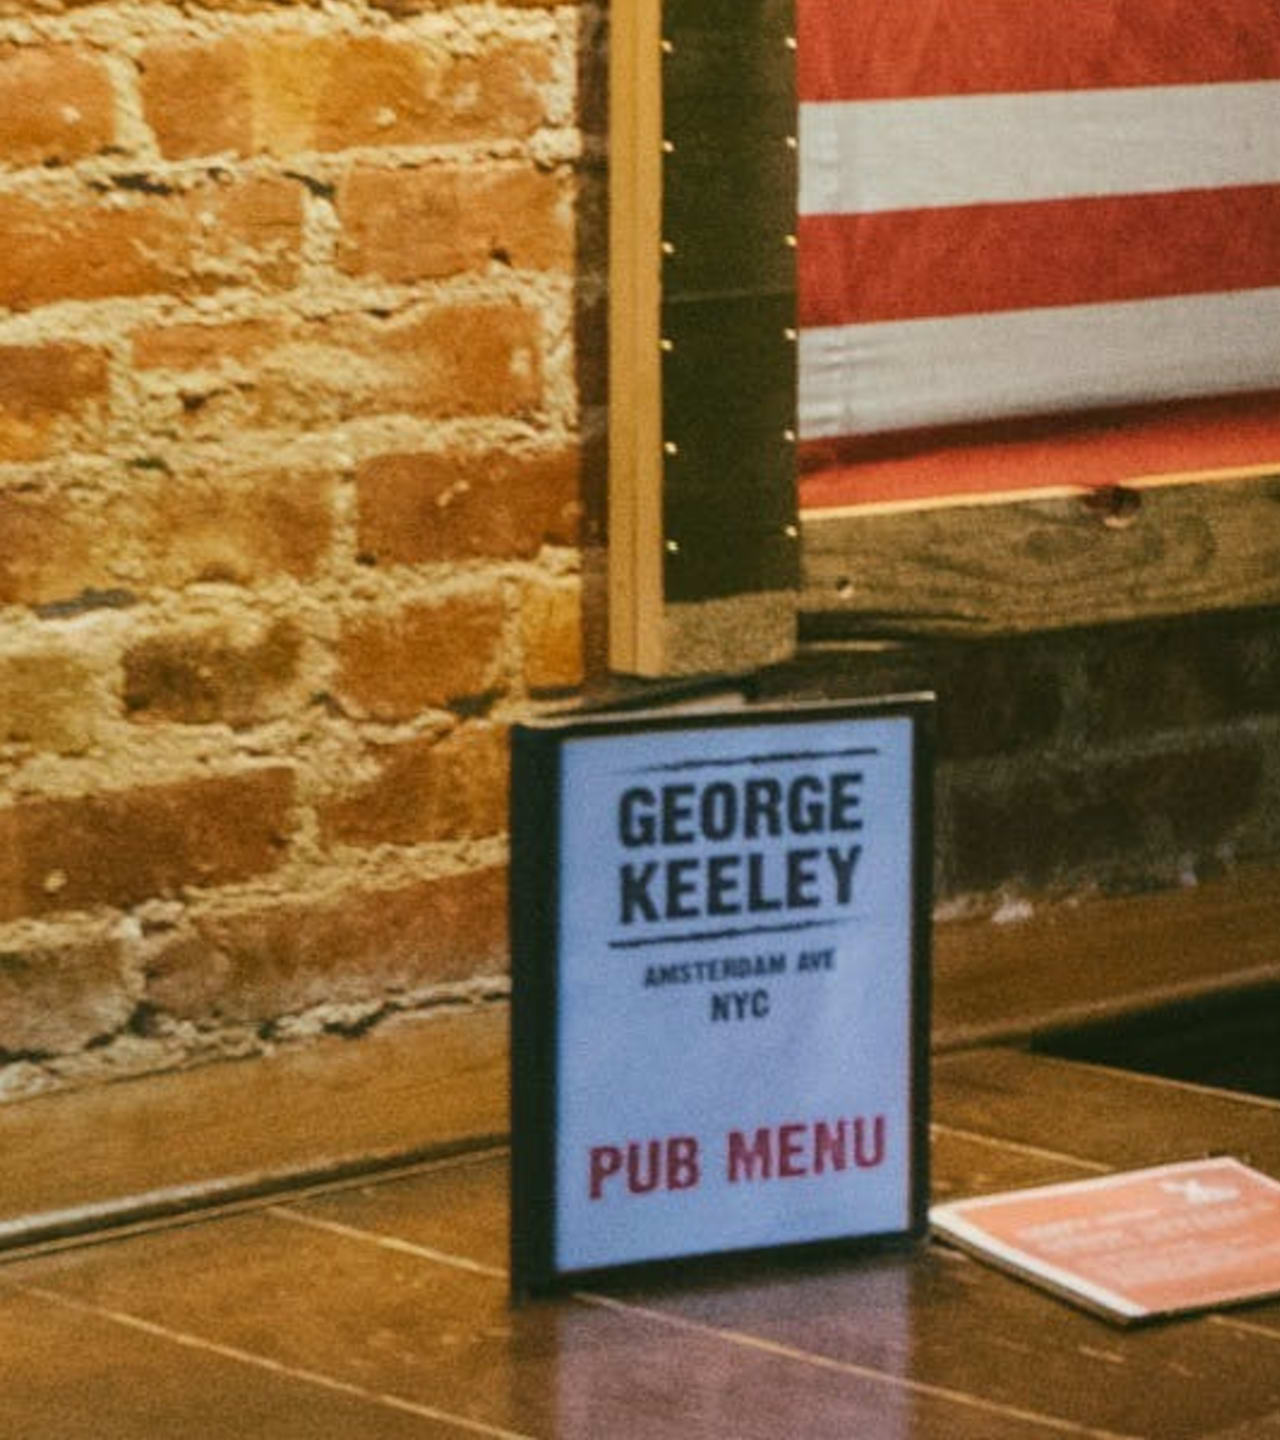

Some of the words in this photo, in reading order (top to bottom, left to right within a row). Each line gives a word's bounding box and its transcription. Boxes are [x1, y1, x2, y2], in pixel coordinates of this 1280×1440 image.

[618, 773, 864, 850] GEORGE
[617, 845, 863, 927] KEELEY
[643, 955, 787, 989] AMSTERDAM
[796, 948, 836, 973] AVE
[710, 988, 770, 1023] NYC
[588, 1134, 700, 1200] PUB
[726, 1114, 888, 1183] MENU
